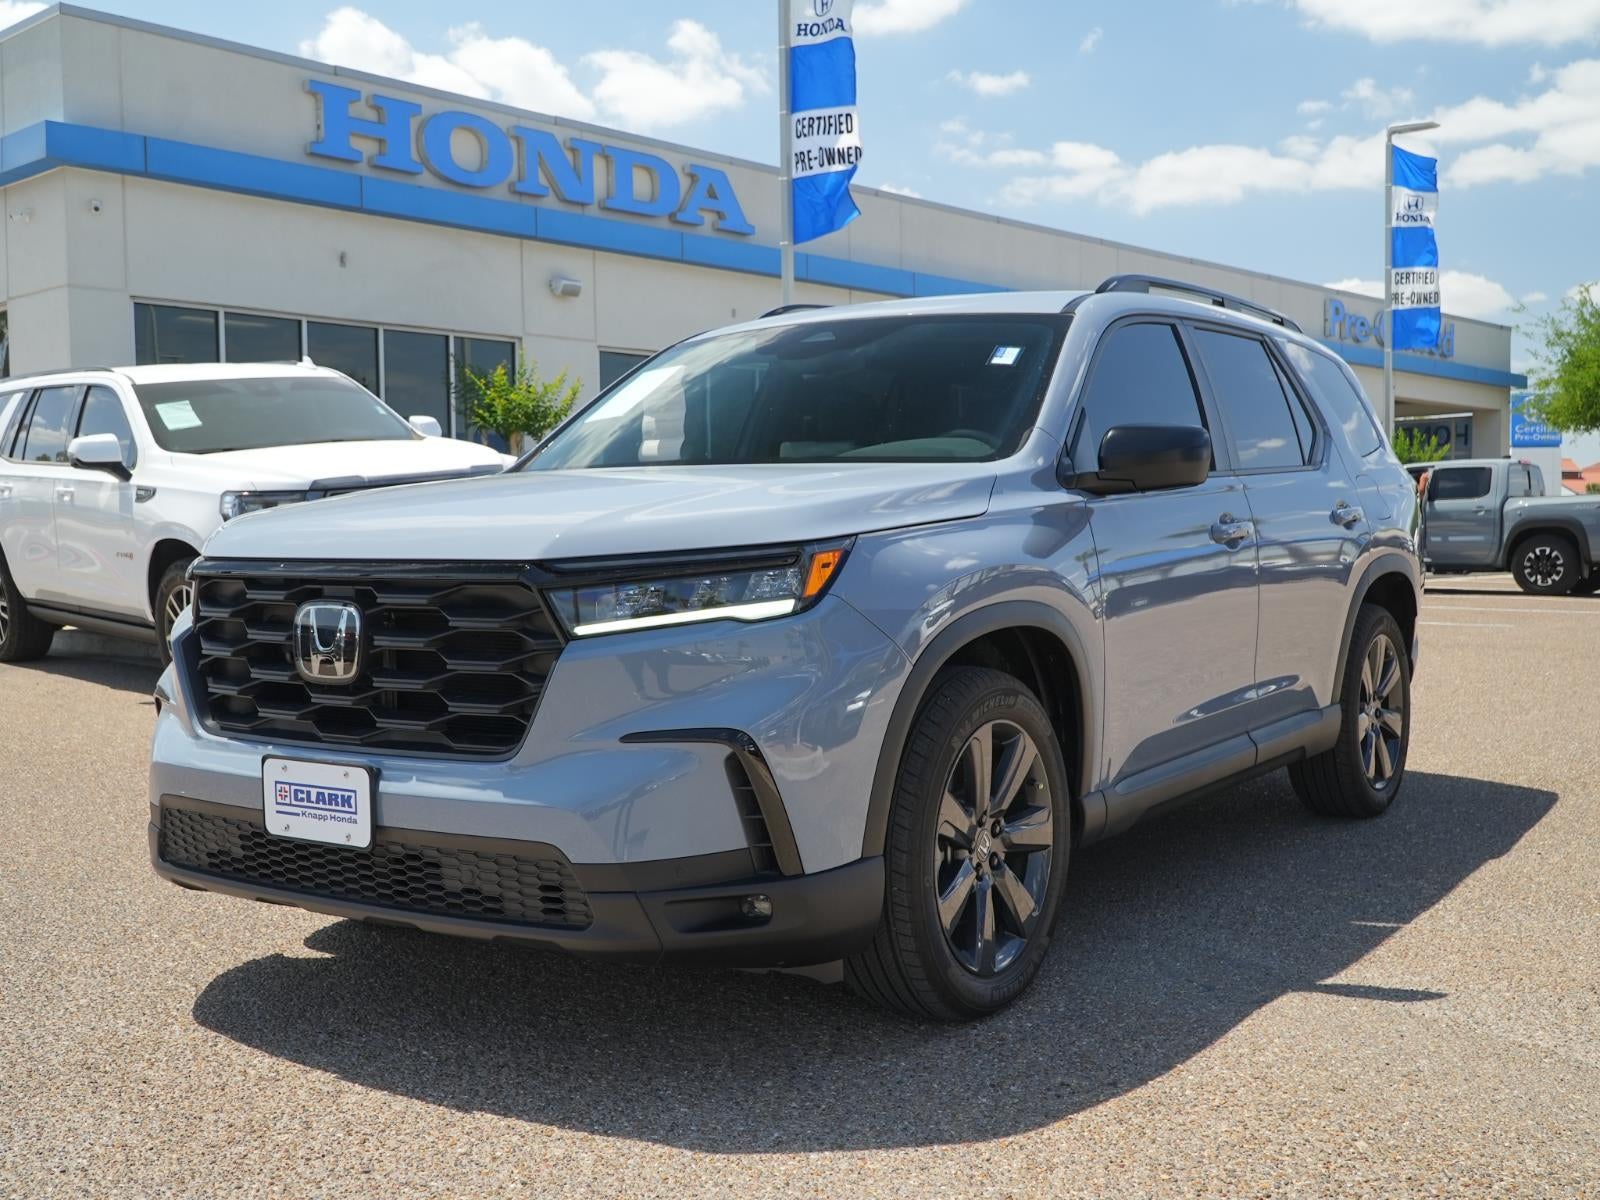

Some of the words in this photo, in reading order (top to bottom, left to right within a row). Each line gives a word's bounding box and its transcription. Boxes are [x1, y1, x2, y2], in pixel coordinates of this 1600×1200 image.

[796, 17, 847, 37] HONDA
[795, 113, 853, 139] CERTIFIED
[305, 79, 756, 237] HONDA
[794, 146, 863, 174] PRE-OWNED
[1394, 271, 1435, 285] CERTIFIED
[293, 788, 353, 809] CLARK
[301, 810, 329, 822] Knapp
[329, 814, 358, 825] Honda
